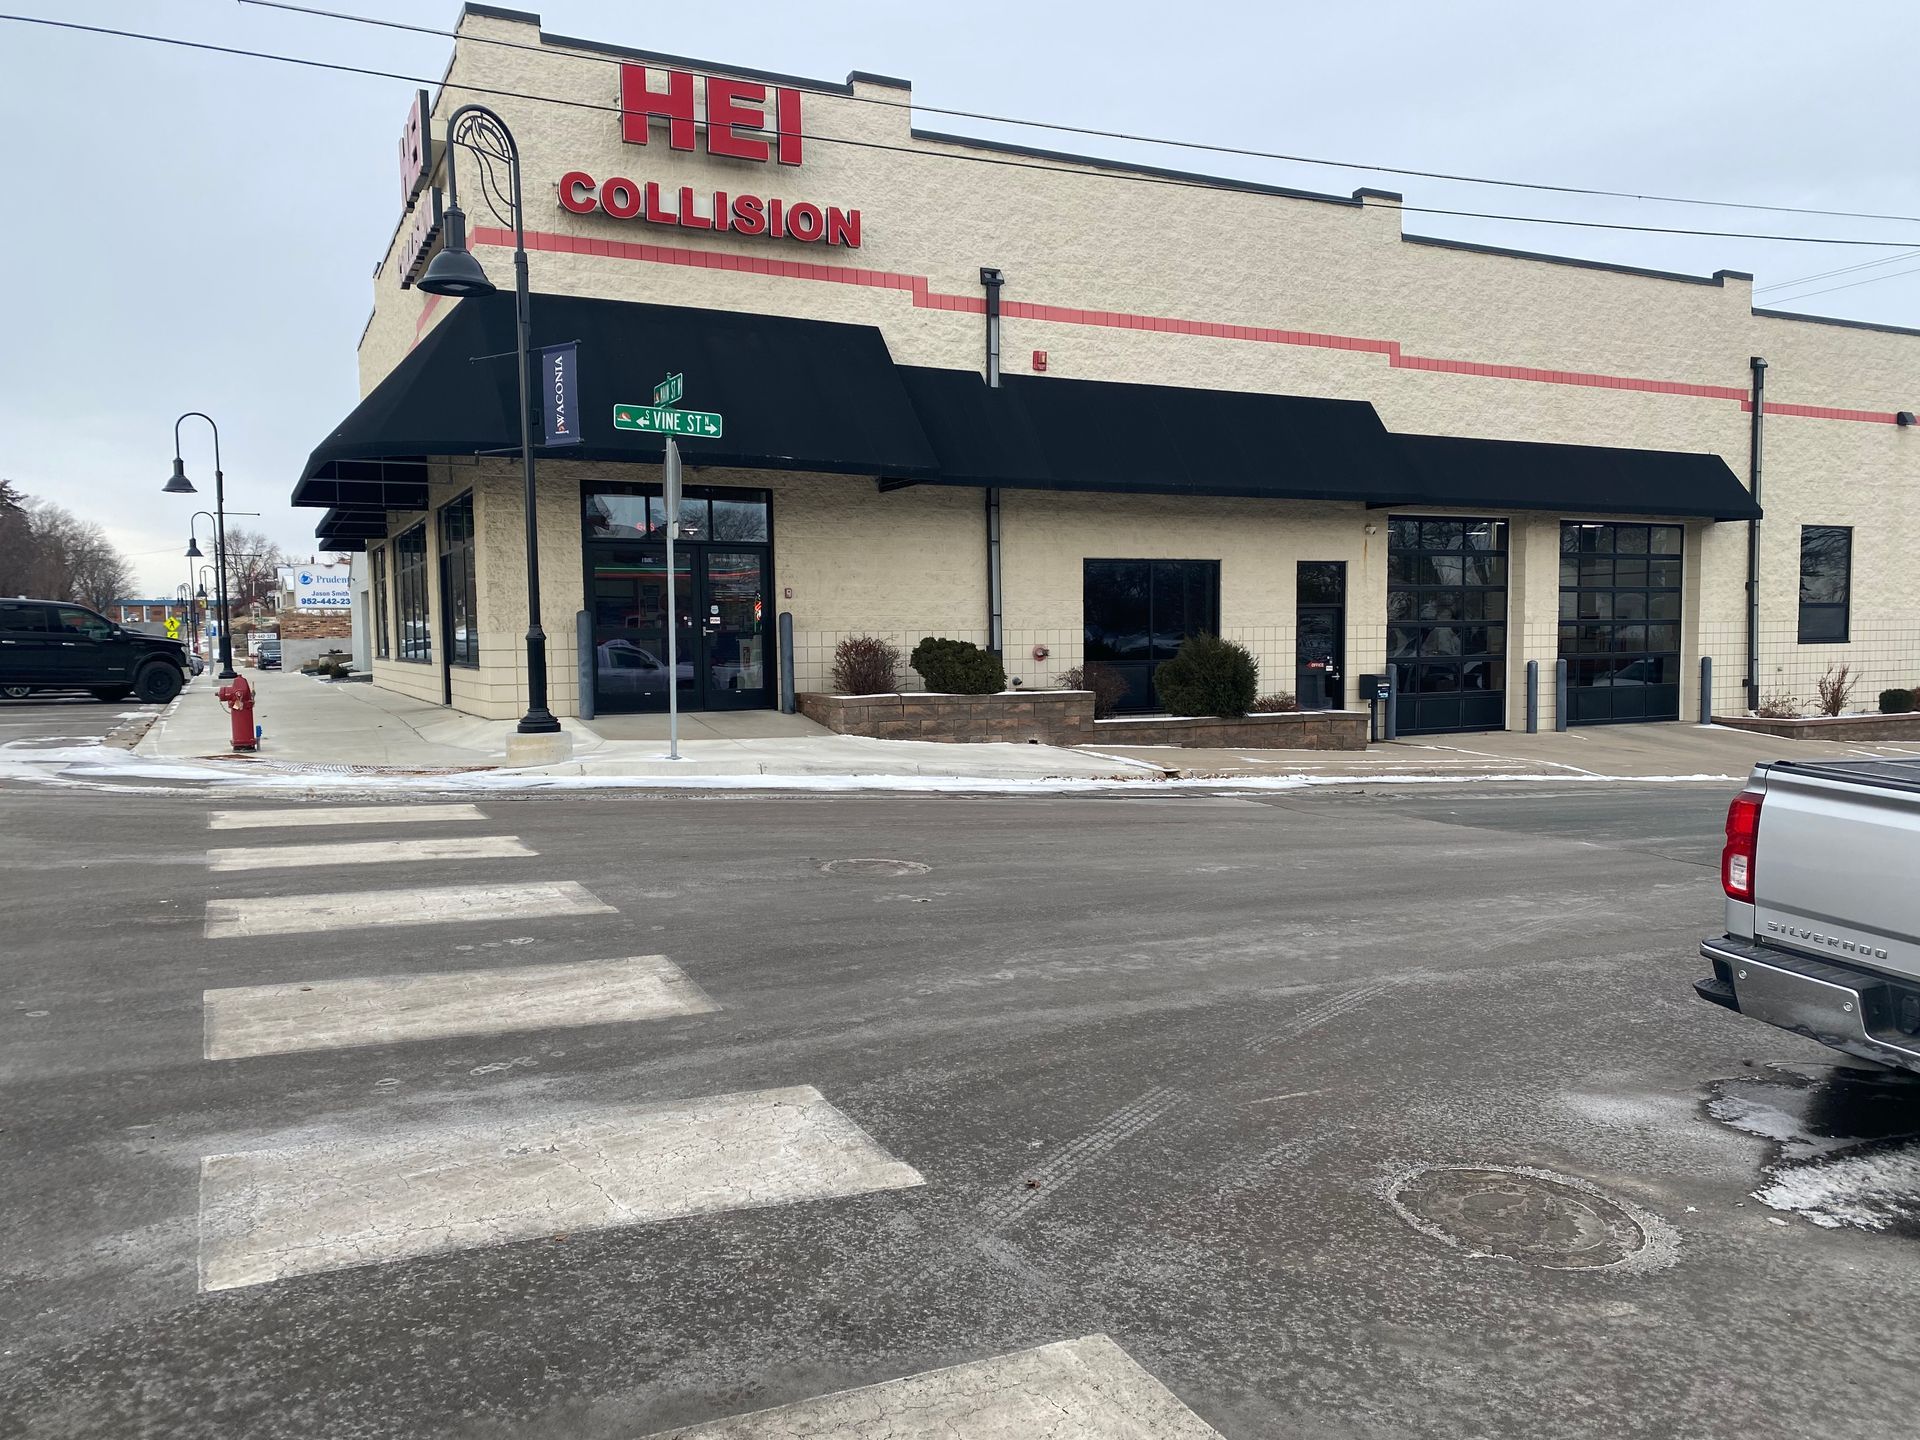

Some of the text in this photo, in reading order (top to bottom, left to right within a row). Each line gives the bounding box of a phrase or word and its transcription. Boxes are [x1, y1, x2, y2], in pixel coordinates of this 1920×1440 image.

[620, 60, 802, 166] HEI
[557, 171, 861, 248] COLLISION
[554, 355, 565, 427] WACONIA
[671, 380, 676, 399] ST
[645, 409, 710, 433] S VINE ST N
[301, 597, 351, 605] 952-442-23
[1767, 921, 1888, 960] SILVERADO
